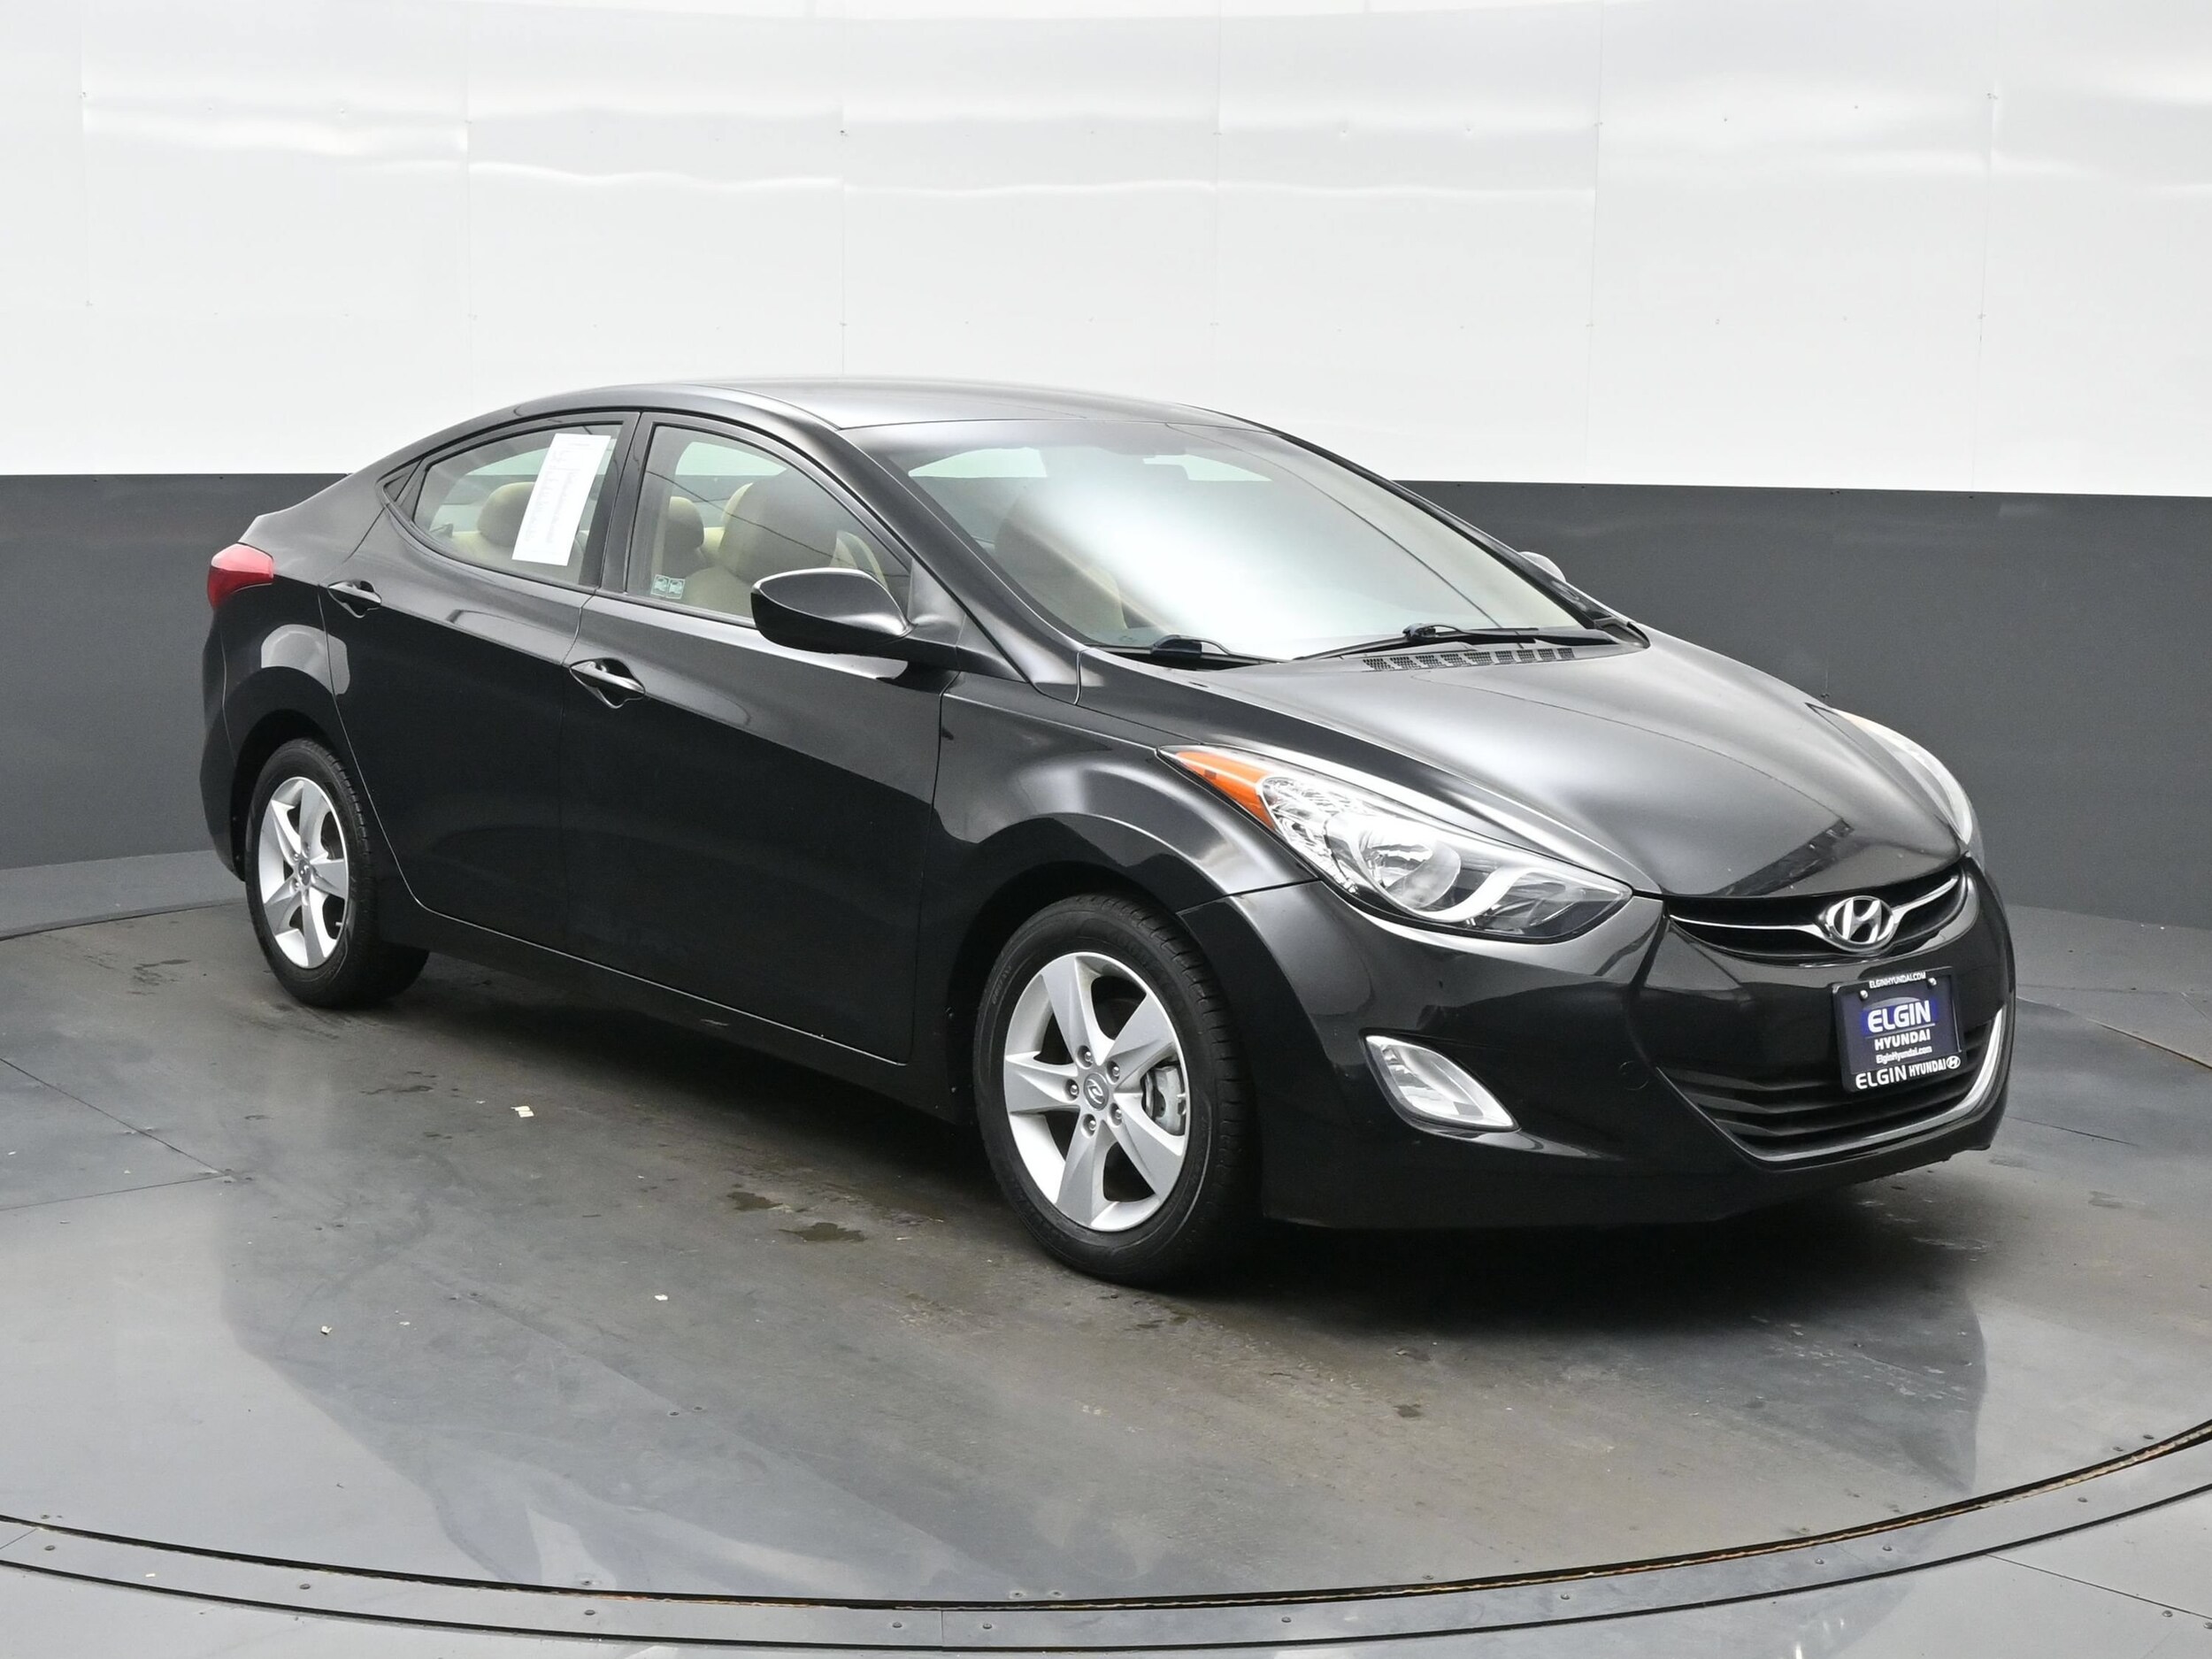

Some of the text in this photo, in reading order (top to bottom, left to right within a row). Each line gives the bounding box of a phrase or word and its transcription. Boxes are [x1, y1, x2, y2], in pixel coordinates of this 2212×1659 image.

[1867, 1000, 1932, 1033] ELGIN
[1874, 1029, 1931, 1050] HYUNDAI
[1855, 1058, 1947, 1089] ELGIN HYUNDAI
